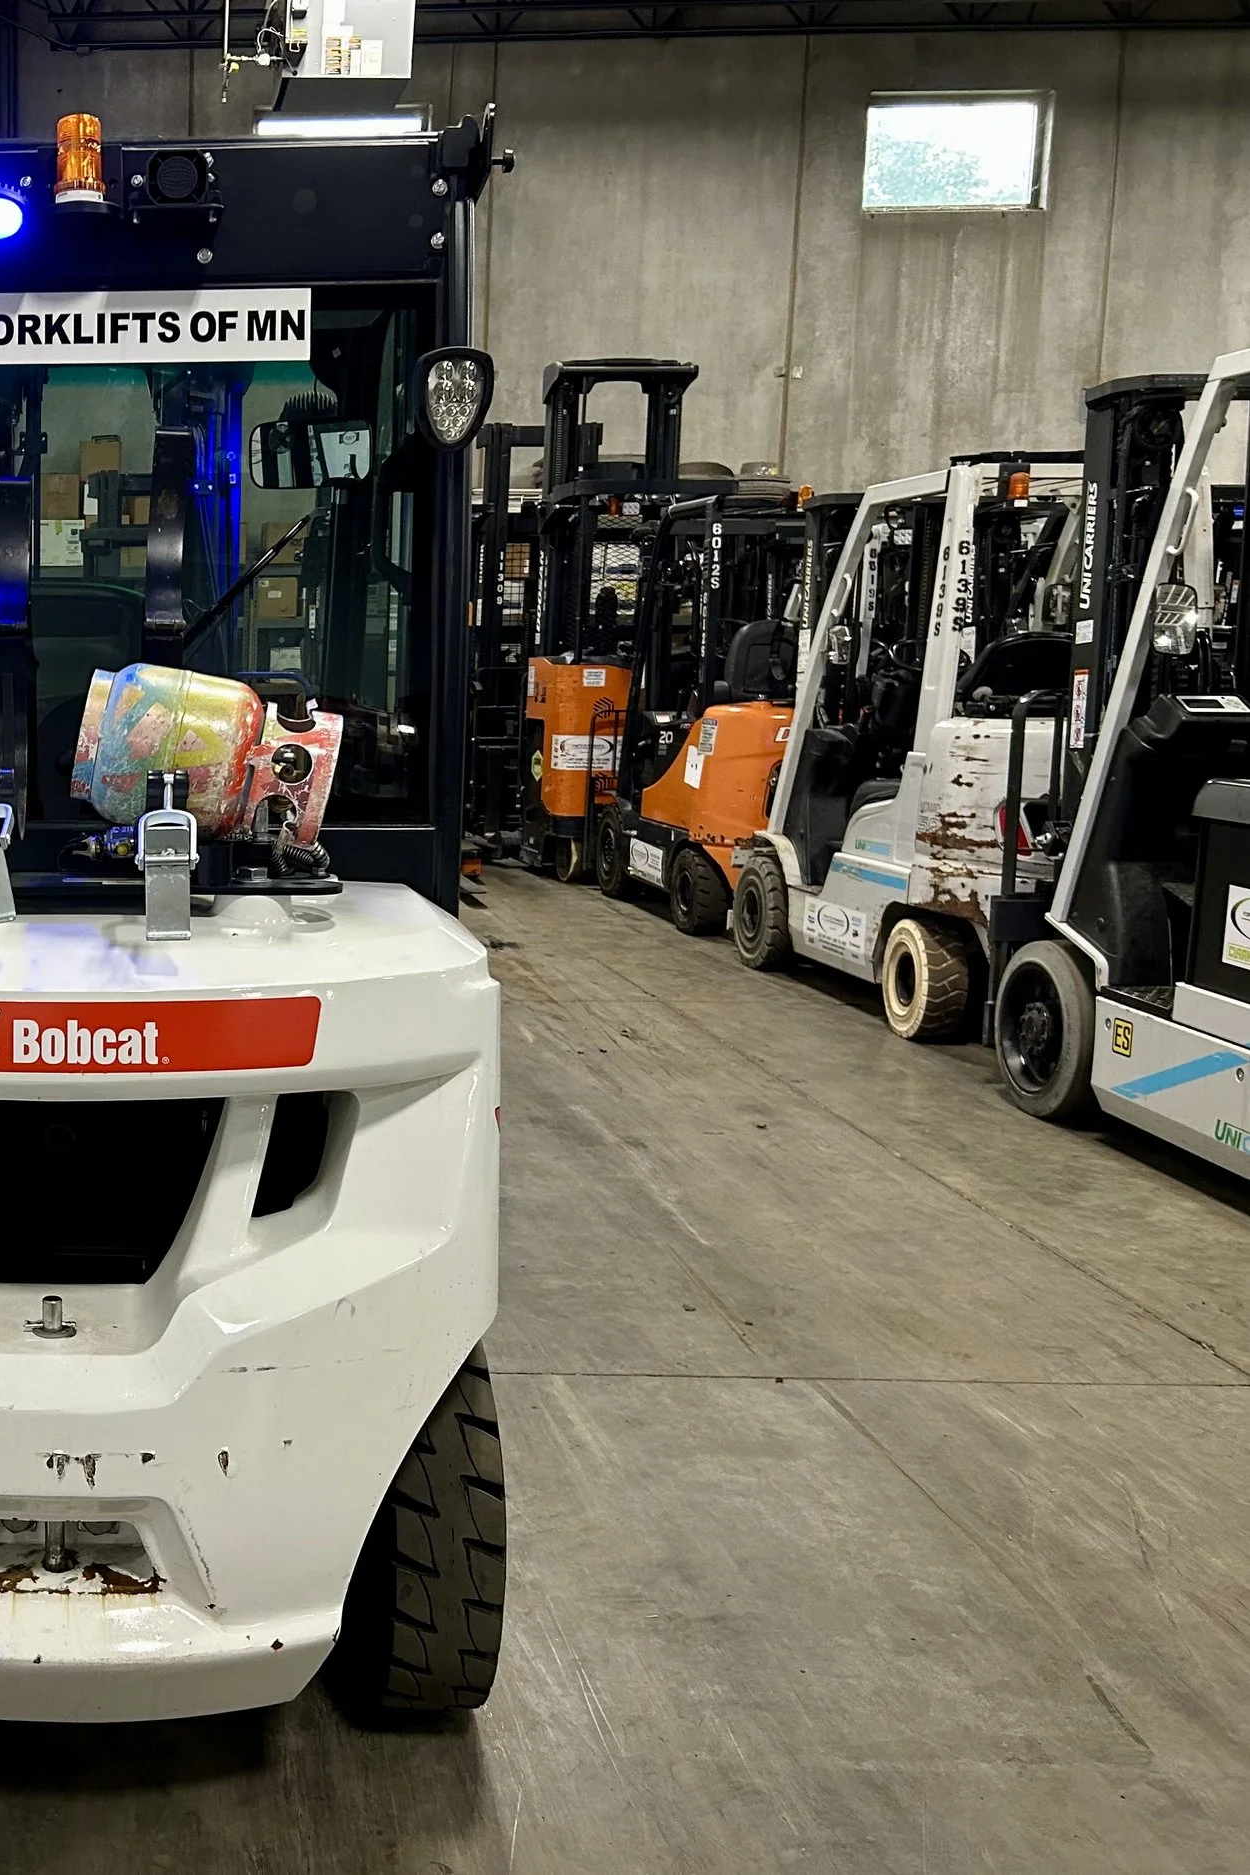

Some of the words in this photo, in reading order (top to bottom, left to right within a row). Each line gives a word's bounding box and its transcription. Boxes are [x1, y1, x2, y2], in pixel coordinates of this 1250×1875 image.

[189, 310, 238, 343] OF
[247, 308, 306, 342] MN
[710, 522, 722, 590] 6012S
[1079, 481, 1098, 610] UNICARRIERS
[496, 551, 504, 605] 11309
[802, 538, 813, 629] UNICARRIERS
[933, 546, 950, 637] 6139S
[952, 540, 971, 632] 6139S
[659, 730, 674, 744] 20
[13, 1019, 159, 1066] Bobcat
[1114, 1024, 1131, 1051] ES
